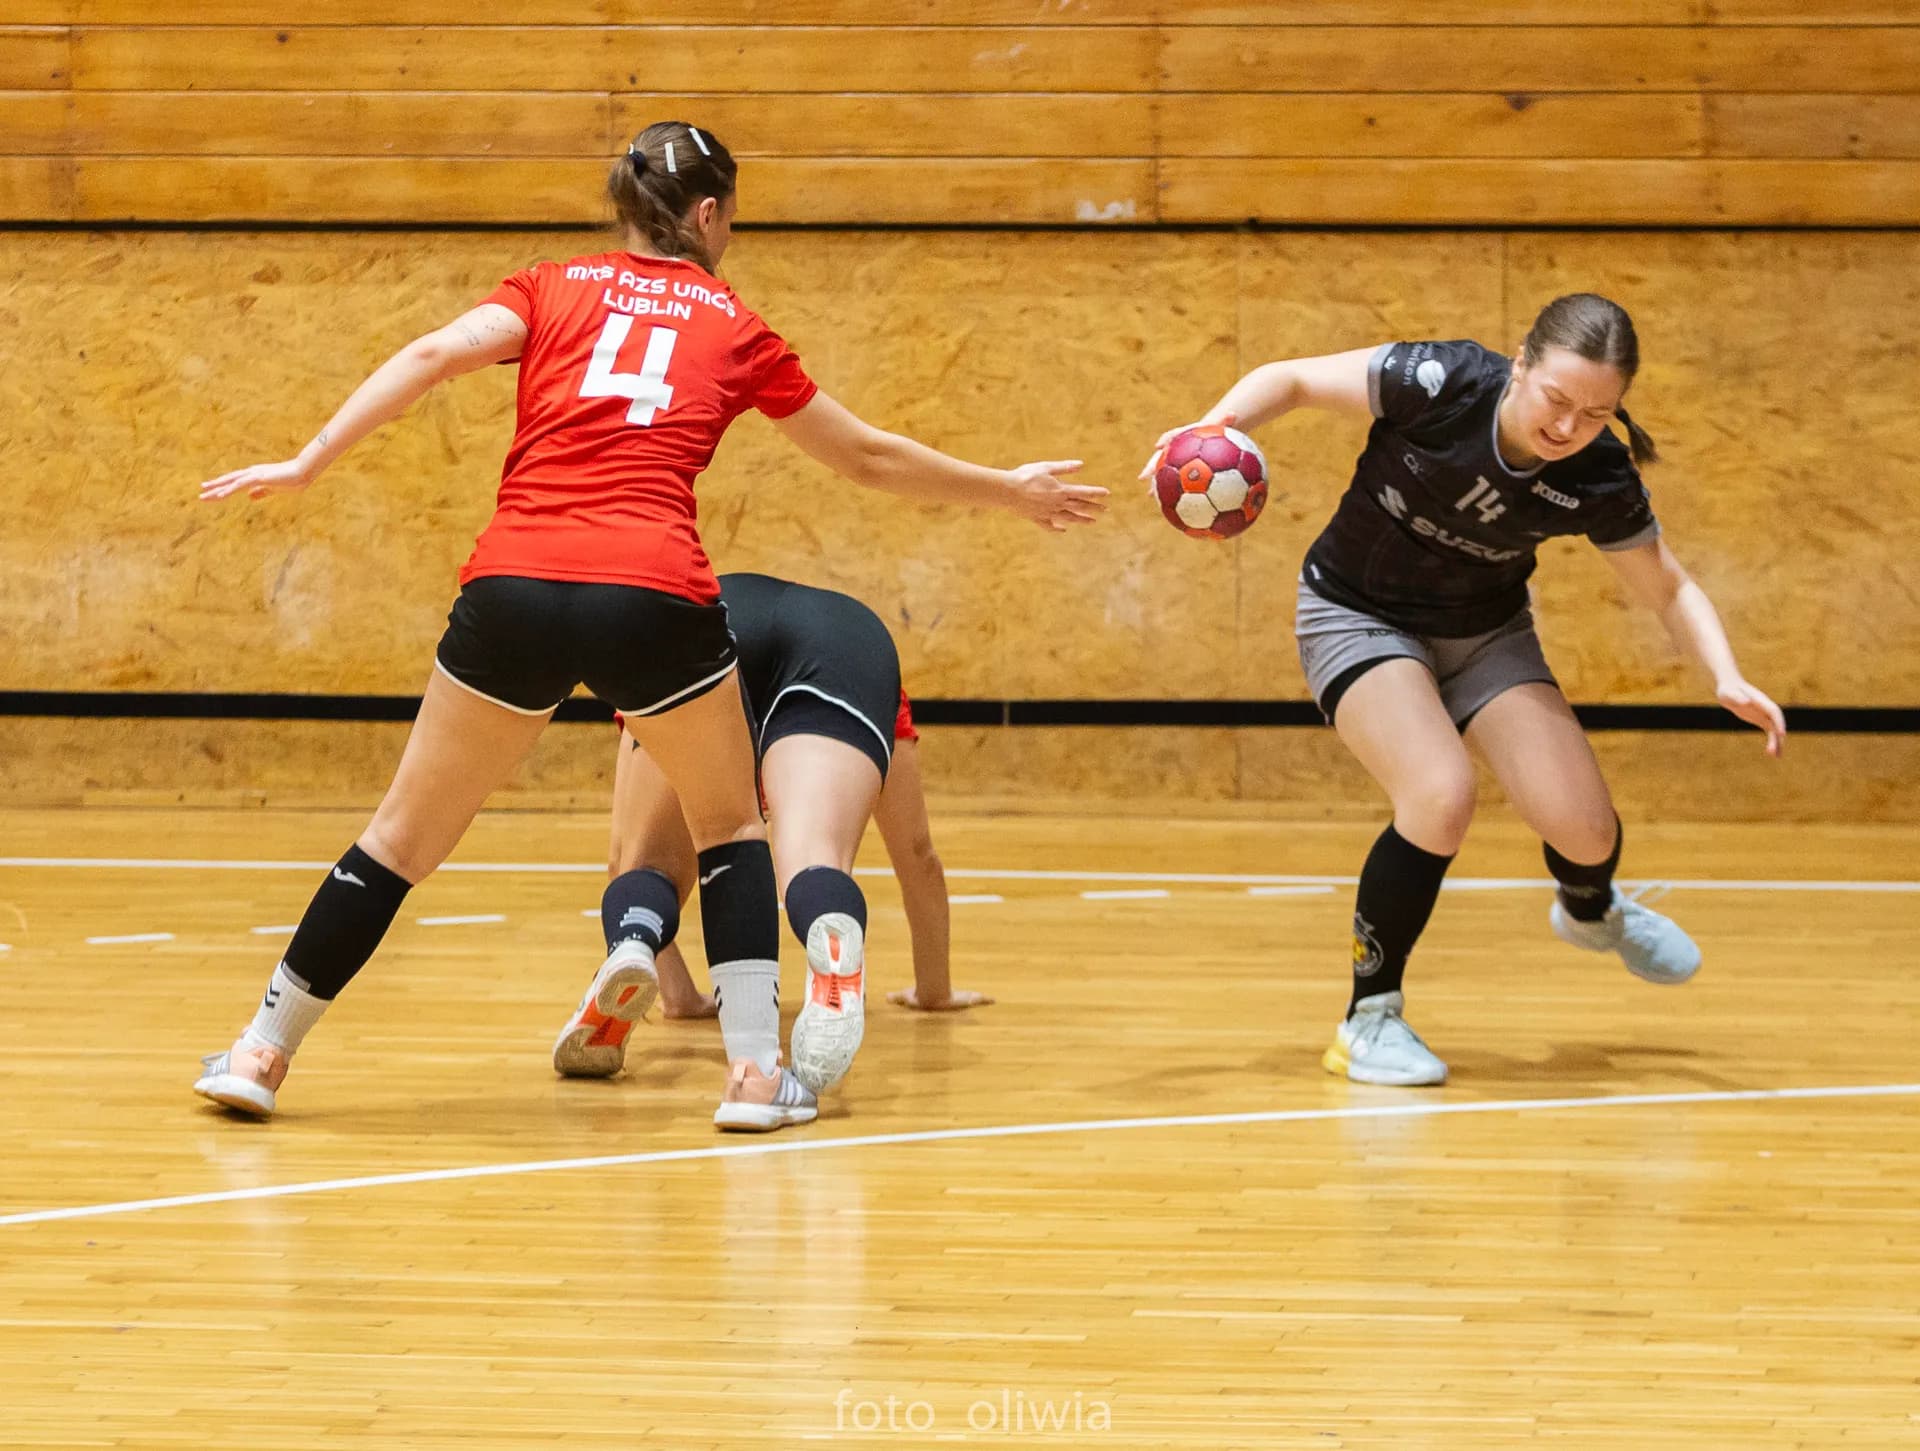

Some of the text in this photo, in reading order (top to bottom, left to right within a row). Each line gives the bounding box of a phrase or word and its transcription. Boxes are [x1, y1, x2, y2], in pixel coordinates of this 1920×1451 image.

[565, 265, 737, 319] MKS AZS UMCS
[602, 288, 692, 321] LUBLIN
[578, 312, 679, 427] 4
[1454, 475, 1507, 524] 14
